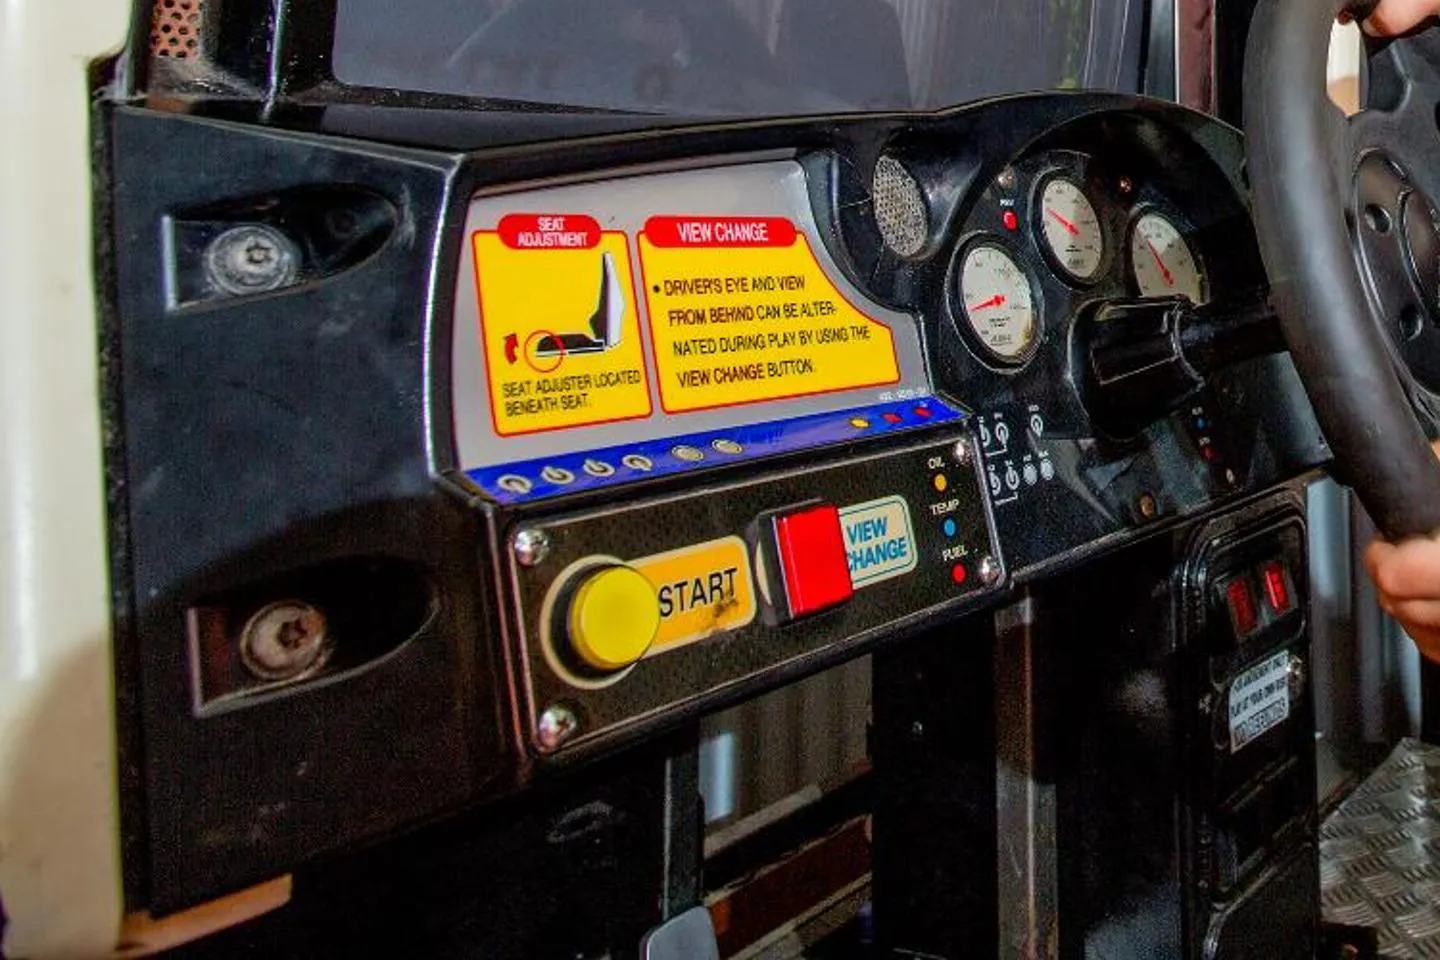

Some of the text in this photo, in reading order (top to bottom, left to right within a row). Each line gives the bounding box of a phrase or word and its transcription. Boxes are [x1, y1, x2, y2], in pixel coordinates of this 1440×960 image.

[537, 217, 565, 231] SEAT
[676, 222, 769, 242] VIEW CHANGE
[517, 231, 588, 247] ADJUSTMENT
[664, 275, 805, 296] DRIVER'S EYE AND VIEW
[668, 300, 838, 327] FROM BEHIND CAN BE ALTER-
[673, 325, 871, 357] NATED DURING PLAY BY USING THE
[502, 369, 641, 397] SEAT ADJUSTER LOCATED
[676, 369, 711, 388] VIEW
[713, 363, 765, 385] CHANGE
[505, 396, 558, 417] BENEATH
[928, 456, 946, 470] OIL
[929, 498, 960, 517] TEMP
[845, 516, 888, 545] VIEW
[942, 543, 968, 562] FUEL
[658, 567, 738, 618] START
